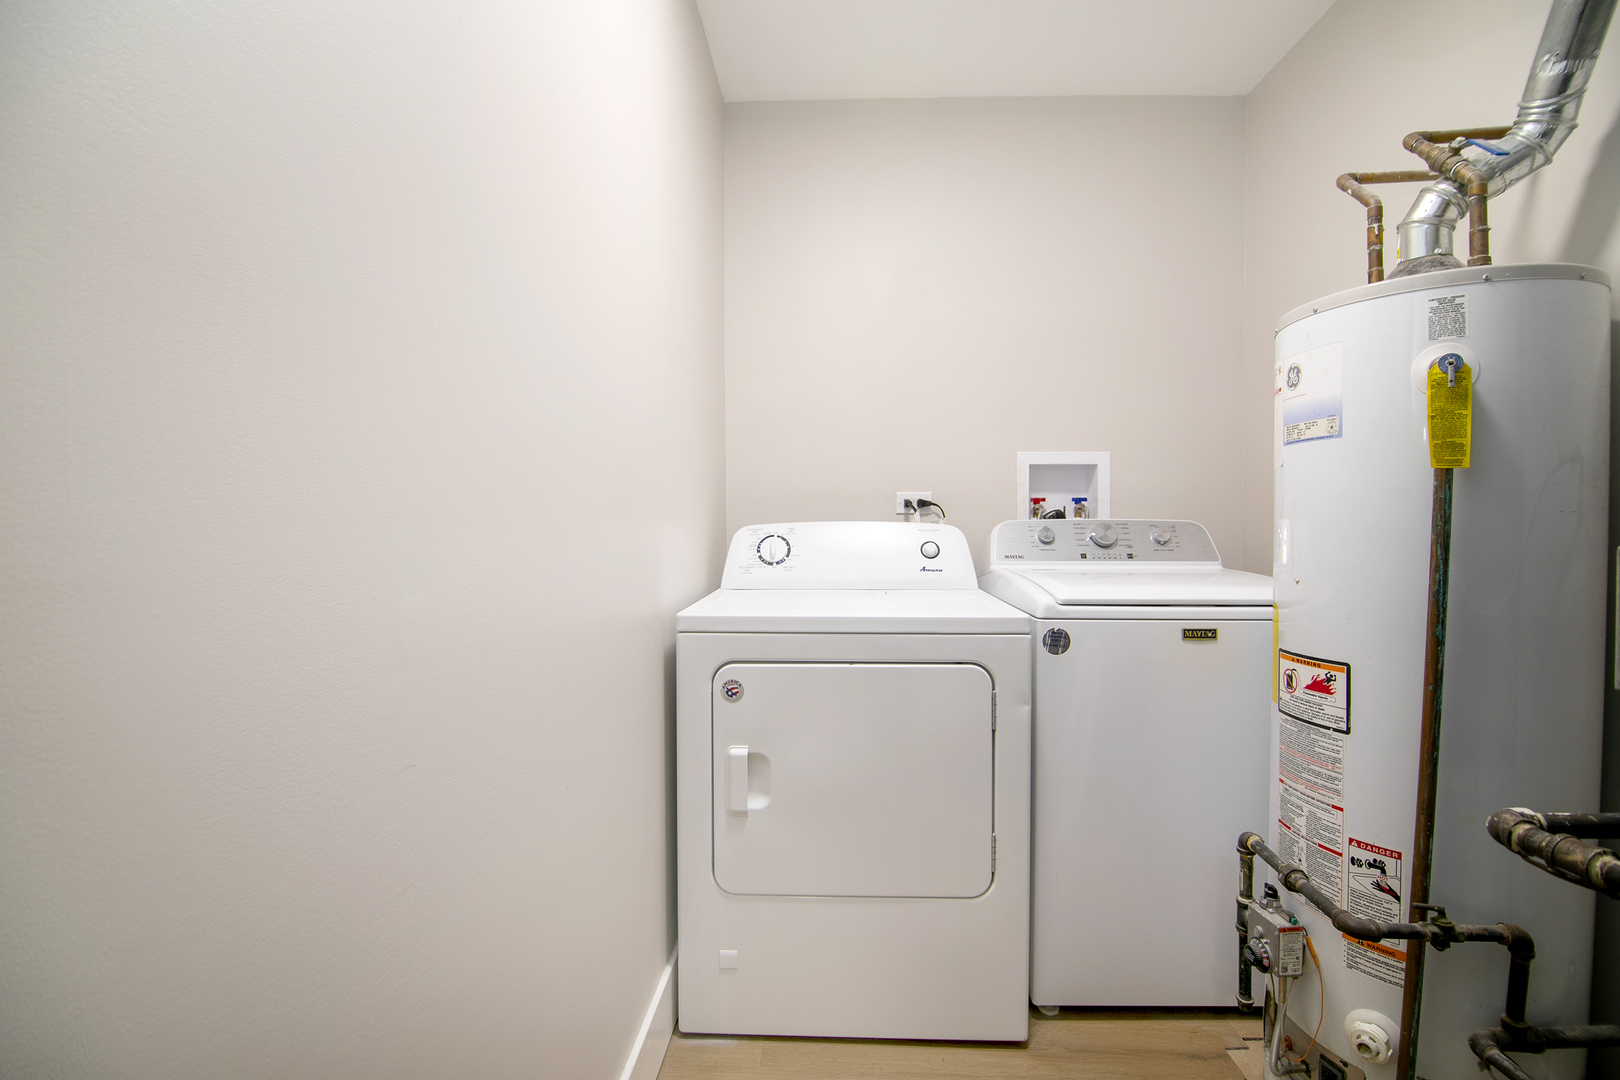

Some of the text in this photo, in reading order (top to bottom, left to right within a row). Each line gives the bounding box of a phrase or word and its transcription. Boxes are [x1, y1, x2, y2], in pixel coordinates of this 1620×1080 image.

[1184, 630, 1216, 638] MAYTAG
[1296, 659, 1321, 668] WARNING
[1360, 844, 1398, 858] DANGER
[1366, 943, 1396, 958] WARNING
